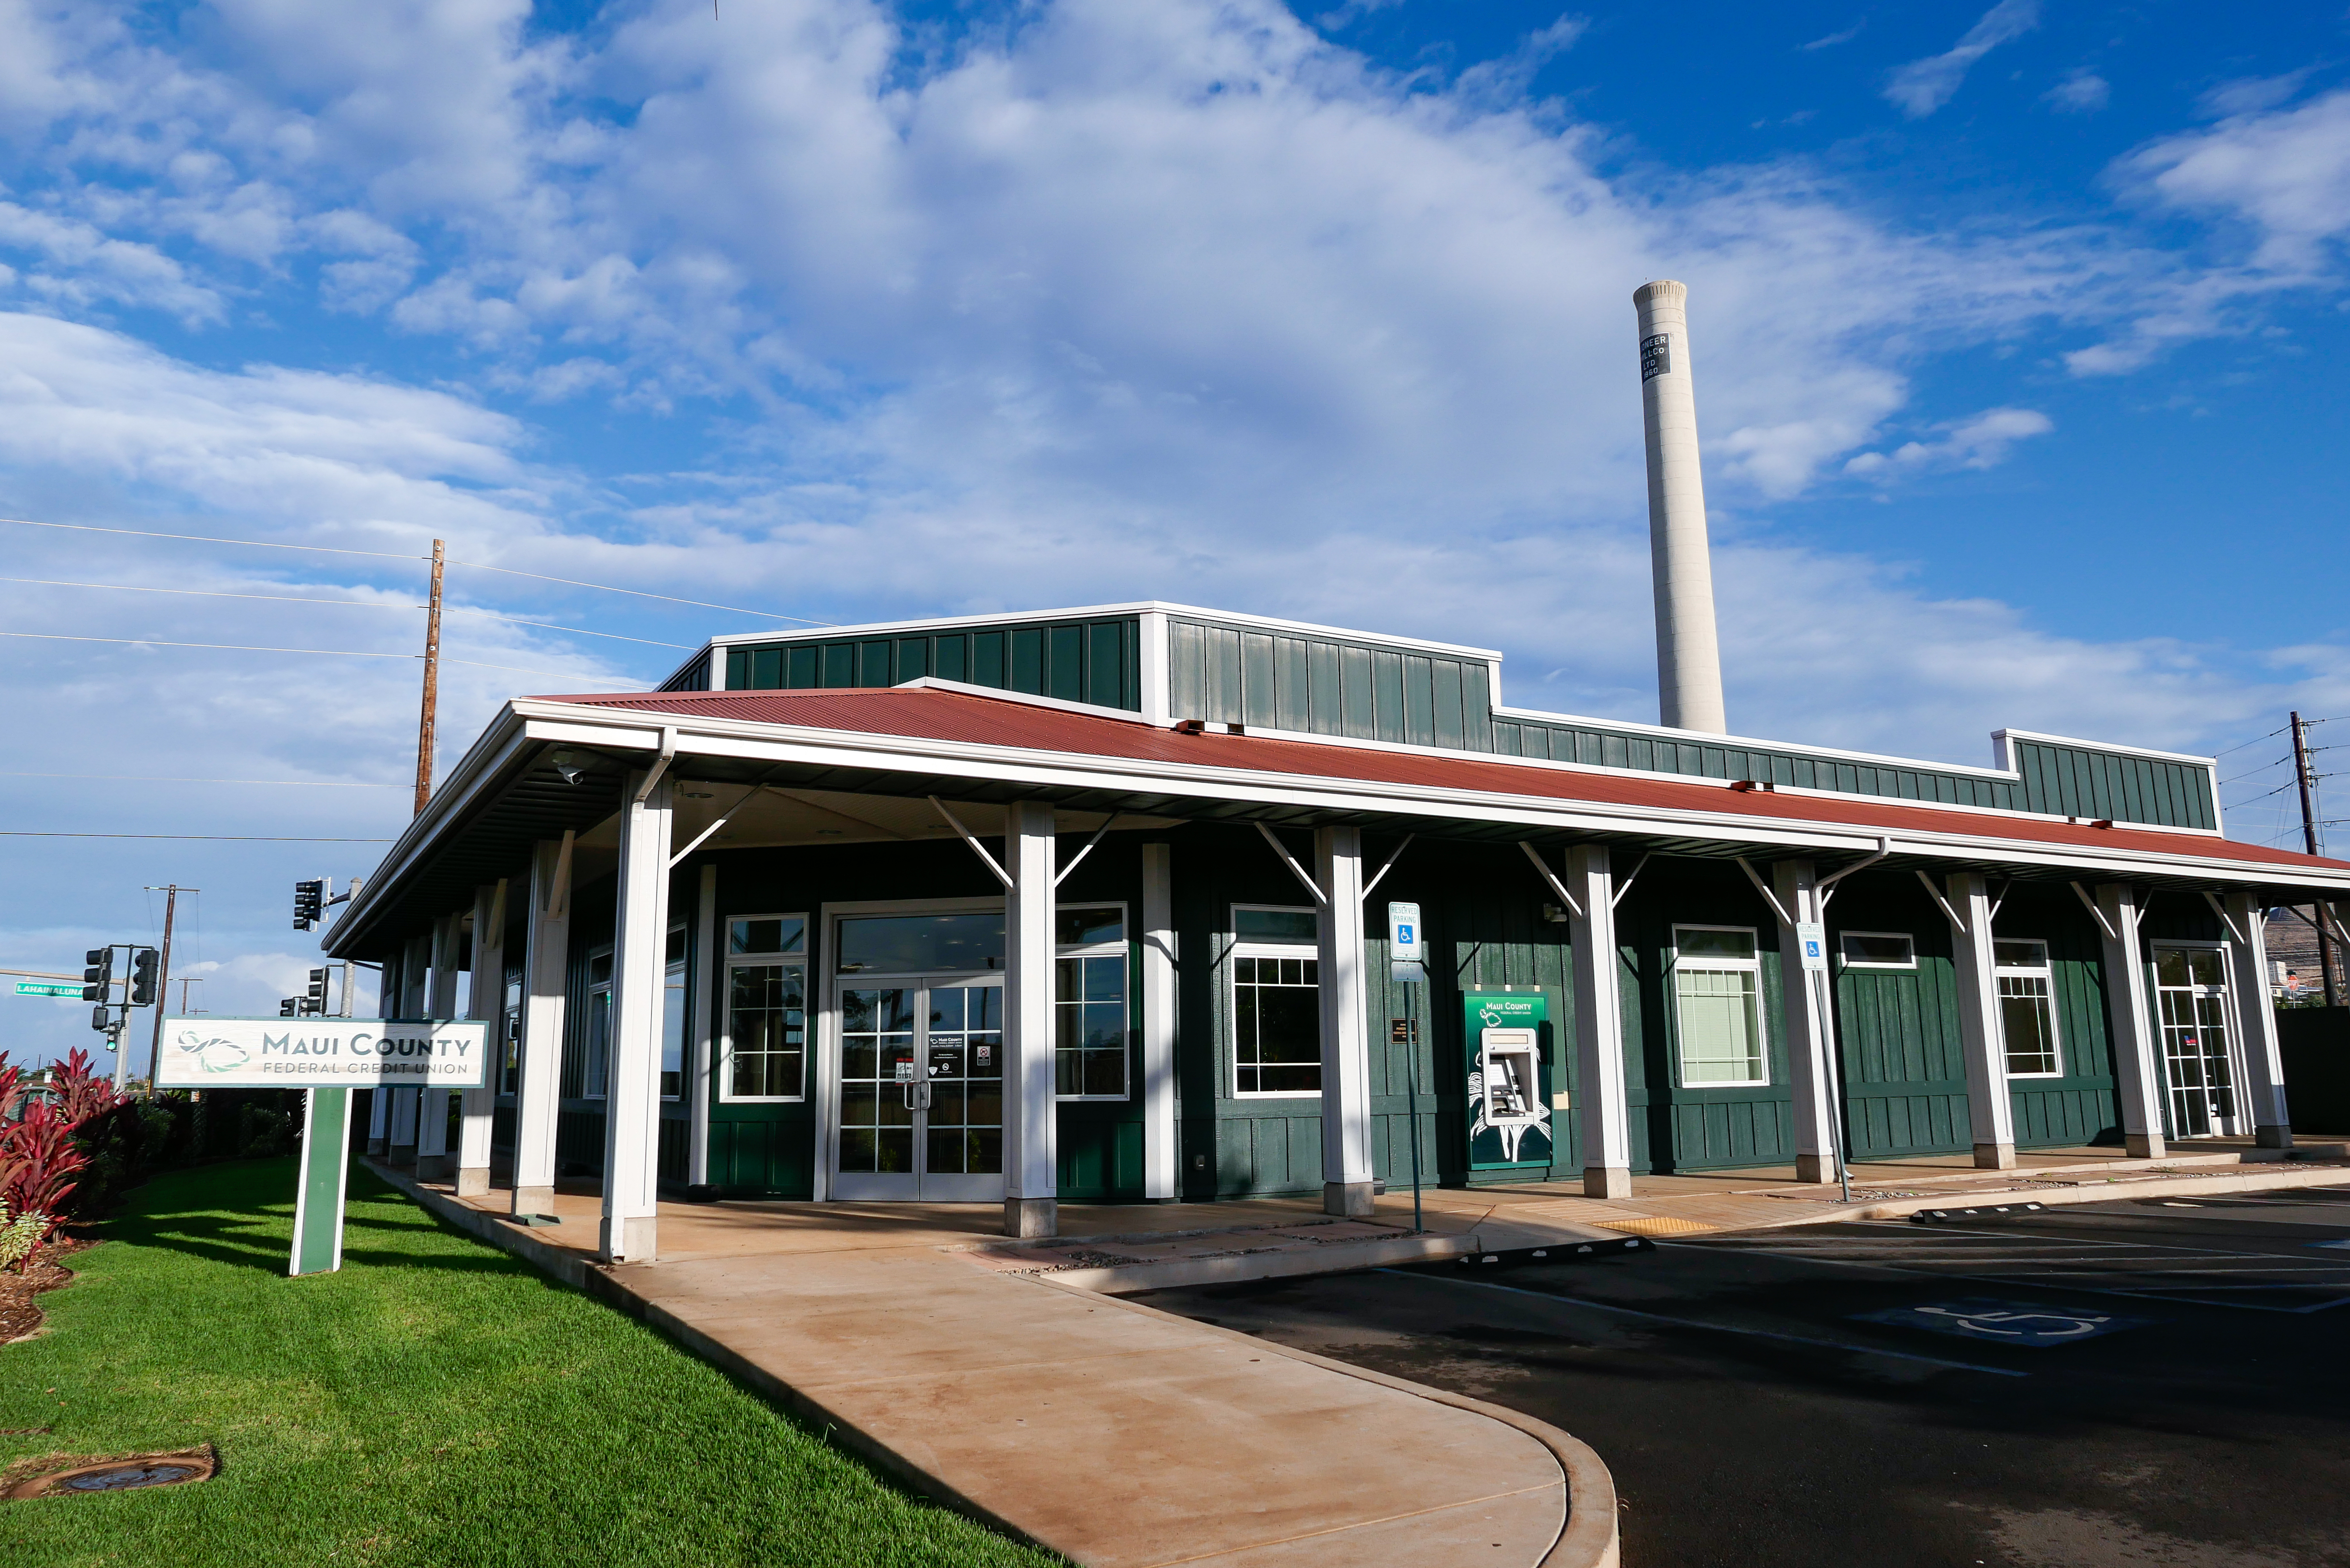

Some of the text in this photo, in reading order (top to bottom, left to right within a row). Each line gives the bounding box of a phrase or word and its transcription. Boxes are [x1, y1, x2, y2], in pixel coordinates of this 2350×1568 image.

[1642, 336, 1666, 351] ONEER
[1643, 359, 1655, 370] LTD
[1391, 906, 1417, 915] RESERVED
[1394, 915, 1416, 923] PARKING
[17, 985, 83, 995] LAHAINALUNA
[262, 1032, 471, 1056] MAUI COUNTY
[264, 1063, 467, 1074] FEDERAL CREDIT UNION
